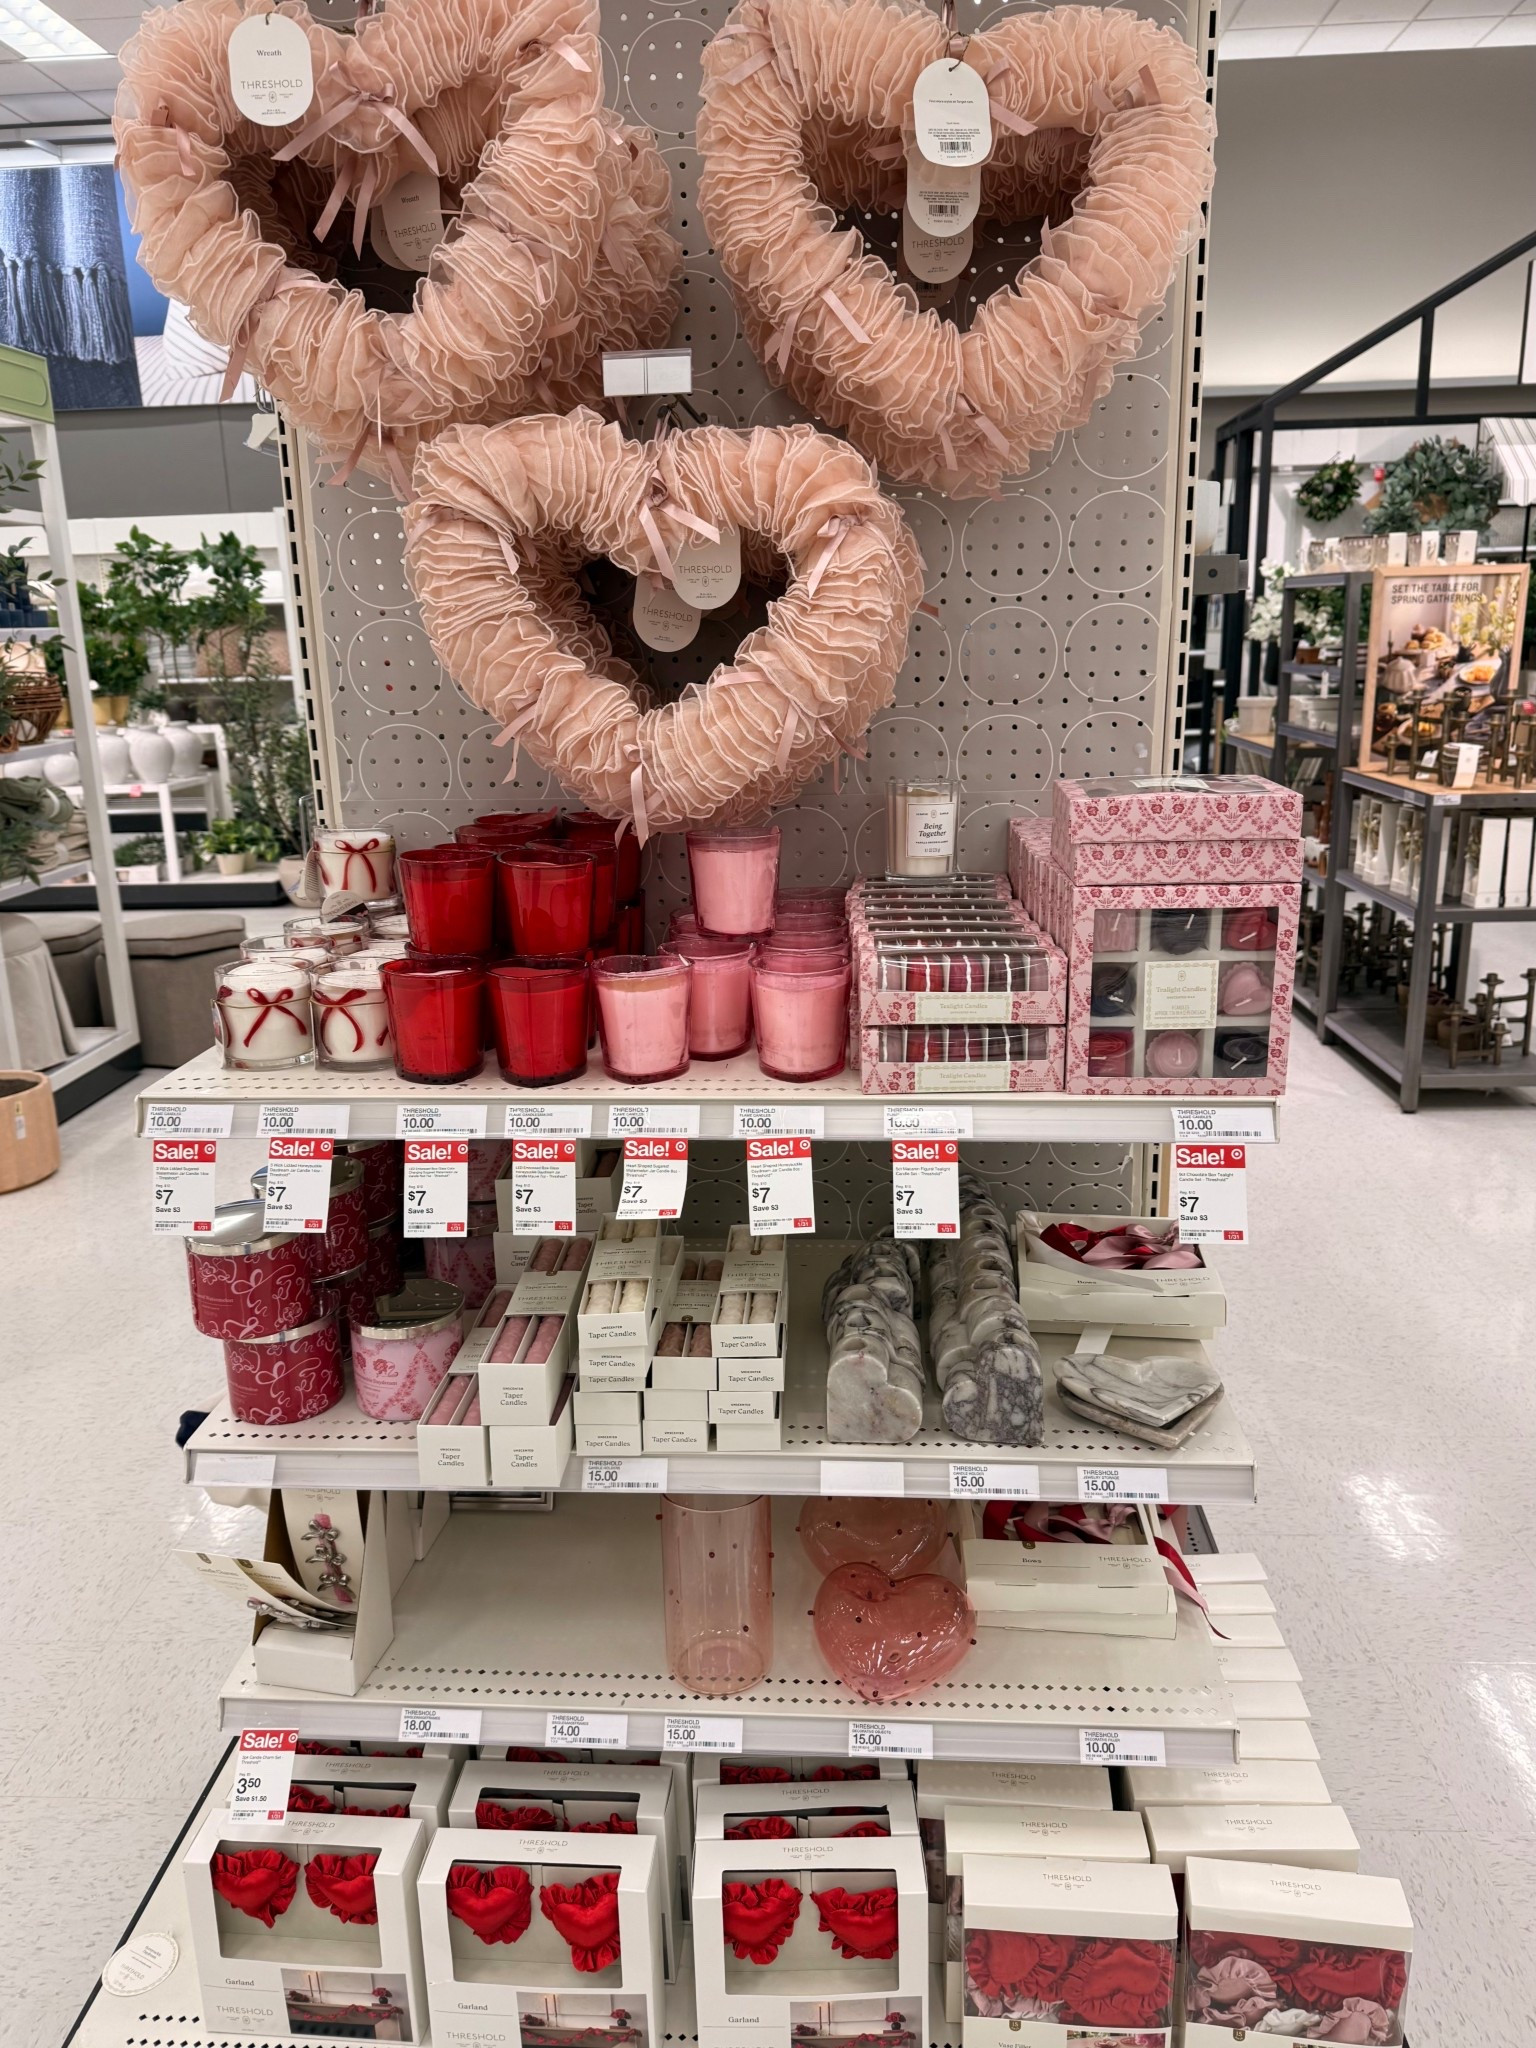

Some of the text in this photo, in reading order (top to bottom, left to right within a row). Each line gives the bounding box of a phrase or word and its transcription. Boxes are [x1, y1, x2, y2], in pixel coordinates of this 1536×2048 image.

[256, 49, 282, 57] Wreath
[240, 78, 304, 90] THRESHOLD
[400, 194, 420, 204] Wreath
[394, 222, 437, 239] THRESHOLD
[912, 237, 965, 249] THRESHOLD
[678, 565, 732, 574] THRESHOLD
[1392, 582, 1480, 594] SET THE TABLE FOR
[1391, 592, 1482, 605] SPRING GATHERINGS
[642, 606, 693, 622] THRESHOLD
[923, 822, 943, 830] Being
[918, 830, 946, 838] Together
[151, 1116, 181, 1127] 10.00
[263, 1117, 294, 1128] 10.00
[403, 1118, 434, 1128] 10.00
[509, 1117, 540, 1128] 10.00
[613, 1116, 644, 1127] 10.00
[740, 1118, 772, 1128] 10.00
[1179, 1120, 1213, 1130] 10.00
[154, 1143, 199, 1160] Sale!
[270, 1140, 315, 1157] Sale!
[407, 1144, 452, 1160] Sale!
[514, 1142, 558, 1159] Sale!
[625, 1140, 670, 1157] Sale!
[749, 1140, 794, 1157] Sale!
[894, 1143, 939, 1160] Sale!
[1176, 1148, 1225, 1165] Sale!
[268, 1186, 286, 1202] $7
[515, 1189, 534, 1205] $7
[623, 1185, 642, 1198] $7
[752, 1187, 770, 1204] $7
[155, 1189, 174, 1206] $7
[408, 1190, 426, 1206] $7
[896, 1190, 915, 1207] $7
[578, 1202, 594, 1210] Taper
[1180, 1196, 1200, 1213] $7
[608, 1330, 637, 1338] Candles
[589, 1360, 608, 1368] Taper
[504, 1392, 524, 1400] Taper
[585, 1440, 603, 1448] Taper
[440, 1453, 460, 1461] Taper
[514, 1454, 533, 1462] Taper
[510, 1460, 538, 1468] Candles
[588, 1470, 618, 1482] 15.00
[954, 1476, 984, 1488] 15.00
[1084, 1480, 1116, 1491] 15.00
[404, 1720, 432, 1731] 18.00
[552, 1725, 580, 1736] 14.00
[667, 1729, 696, 1740] 15.00
[853, 1734, 882, 1745] 15.00
[243, 1732, 284, 1749] Sale!
[1086, 1742, 1116, 1754] 10.00
[543, 1769, 590, 1778] THRESHOLD
[991, 1771, 1036, 1781] THRESHOLD
[781, 1788, 830, 1796] THRESHOLD
[287, 1820, 335, 1828] THRESHOLD
[1020, 1821, 1068, 1829] THRESHOLD
[1224, 1818, 1273, 1826] THRESHOLD
[519, 1838, 568, 1846] THRESHOLD
[1042, 1873, 1092, 1882] THRESHOLD
[1270, 1879, 1322, 1891] THRESHOLD
[225, 1978, 255, 1987] Garland
[216, 2005, 274, 2016] THRESHOLD
[457, 2002, 488, 2012] Garland
[446, 2031, 506, 2042] THRESHOLD
